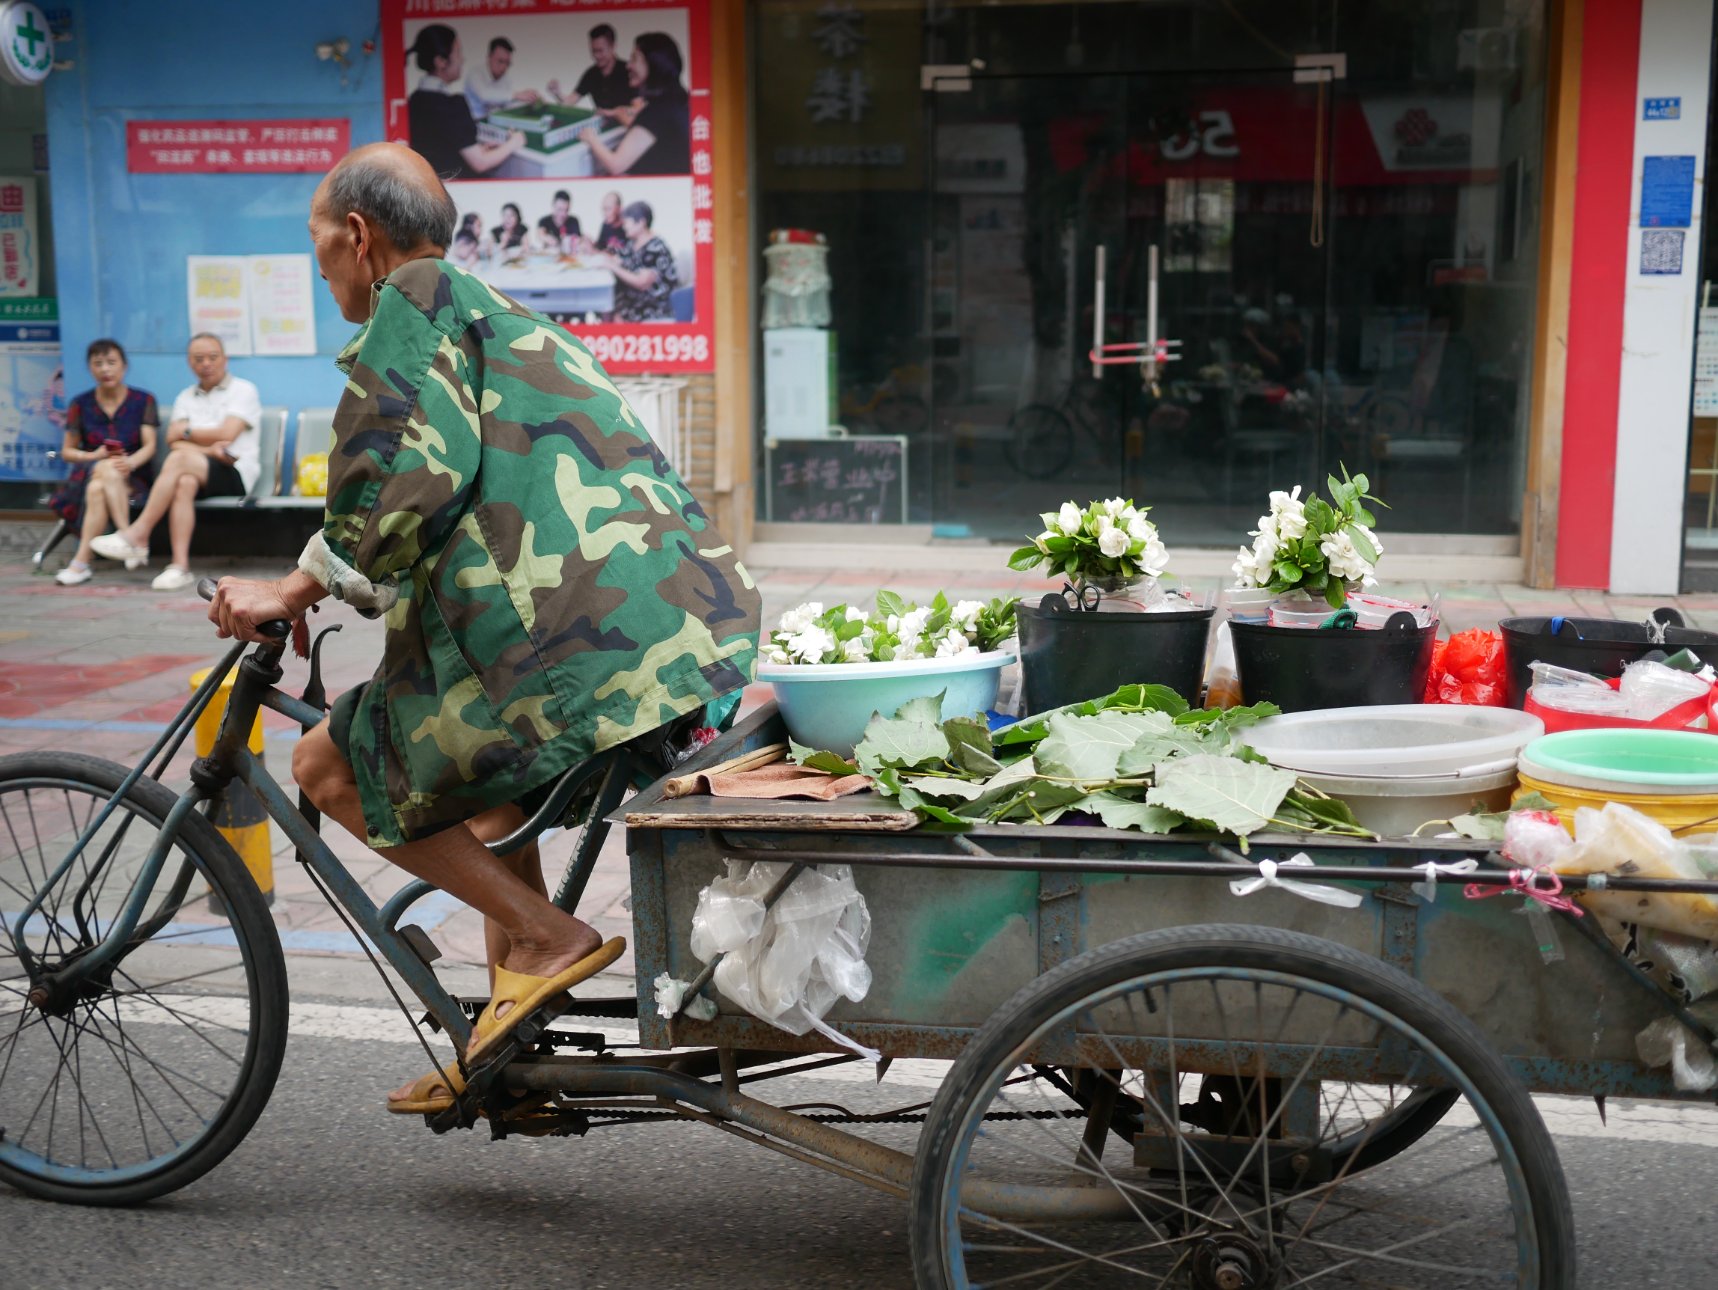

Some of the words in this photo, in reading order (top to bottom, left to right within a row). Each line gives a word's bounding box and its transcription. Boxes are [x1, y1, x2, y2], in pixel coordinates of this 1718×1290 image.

[389, 98, 409, 145] 厂
[690, 88, 713, 244] 一台也批发
[576, 334, 709, 362] 990281998
